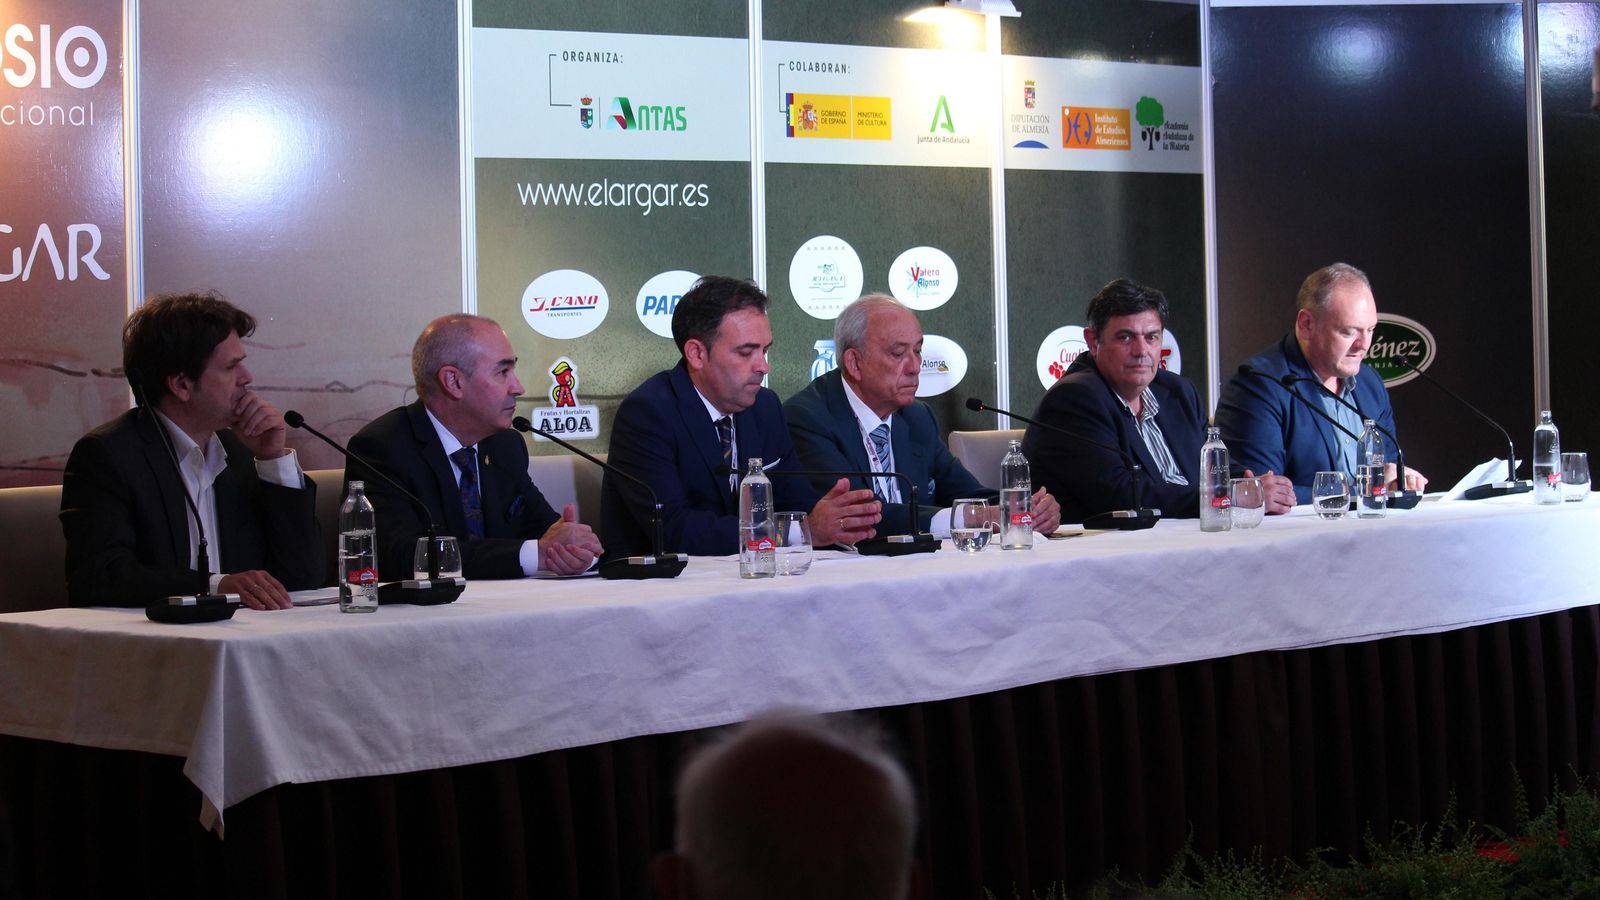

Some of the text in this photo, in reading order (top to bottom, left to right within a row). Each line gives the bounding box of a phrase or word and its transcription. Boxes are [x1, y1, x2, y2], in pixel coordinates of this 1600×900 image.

[0, 23, 108, 89] SIO
[562, 50, 624, 64] ORGANIZA:
[789, 60, 851, 74] COLABORAN:
[820, 110, 847, 118] GOBIERNO
[857, 111, 884, 119] MINISTERIO
[1010, 113, 1050, 124] DIPUTACIÓN
[1094, 112, 1119, 123] Instituto
[820, 116, 847, 125] DE ESPAÑA
[1163, 121, 1189, 131] Academia
[1011, 124, 1050, 134] DE ALMERÍA
[1094, 124, 1126, 135] de Estudios
[917, 136, 932, 144] Junta
[942, 136, 970, 144] Andalucía
[1188, 132, 1194, 141] de
[517, 178, 710, 216] www.elargar.es
[910, 266, 940, 282] Valero
[917, 277, 940, 288] Alonso
[1365, 335, 1420, 359] énez
[921, 359, 946, 368] Alonso
[563, 408, 591, 416] Hortalizas
[540, 416, 593, 434] ALOA
